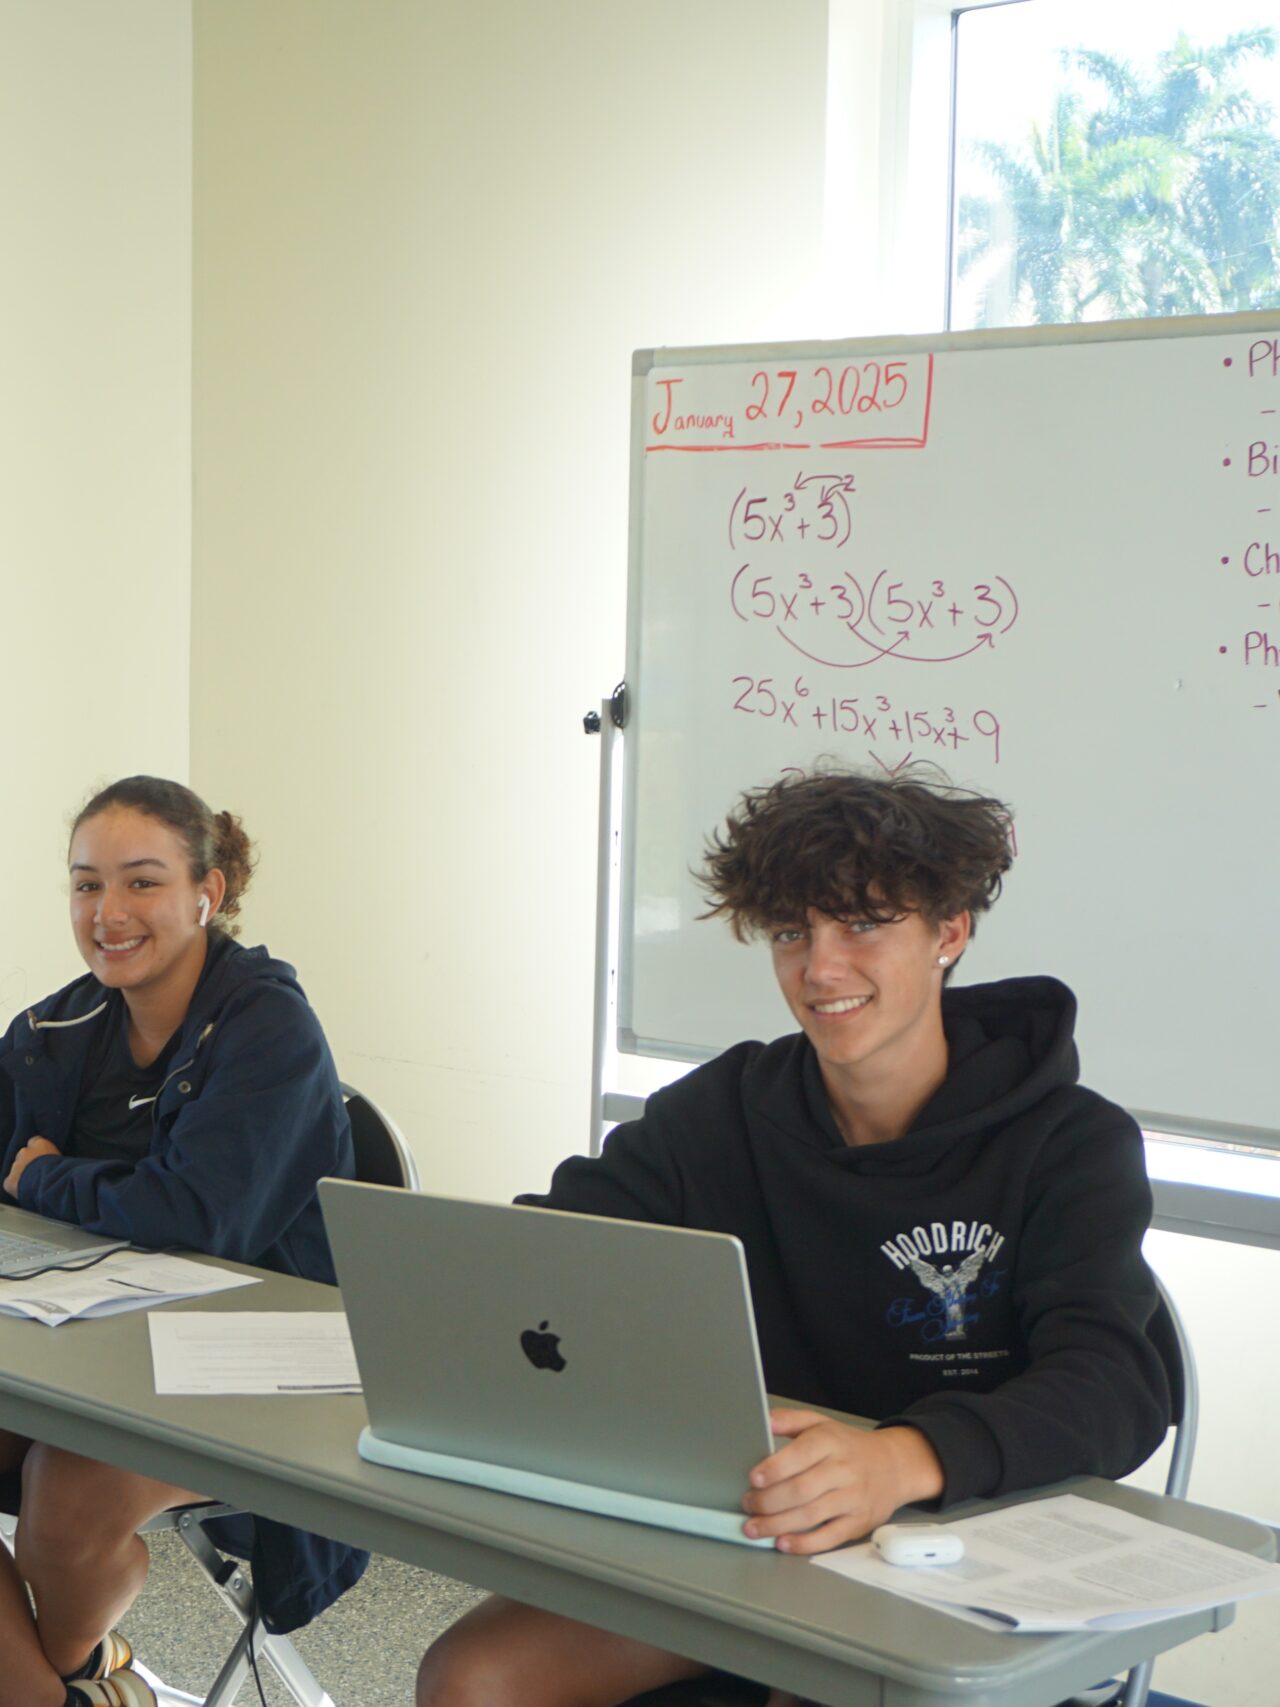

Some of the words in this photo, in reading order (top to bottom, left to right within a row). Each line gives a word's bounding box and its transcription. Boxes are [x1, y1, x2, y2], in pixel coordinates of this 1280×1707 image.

[652, 378, 735, 438] January
[880, 1220, 1005, 1270] HOODRICH
[909, 1352, 944, 1361] PRODUCT
[945, 1352, 955, 1361] OF
[957, 1351, 972, 1360] THE
